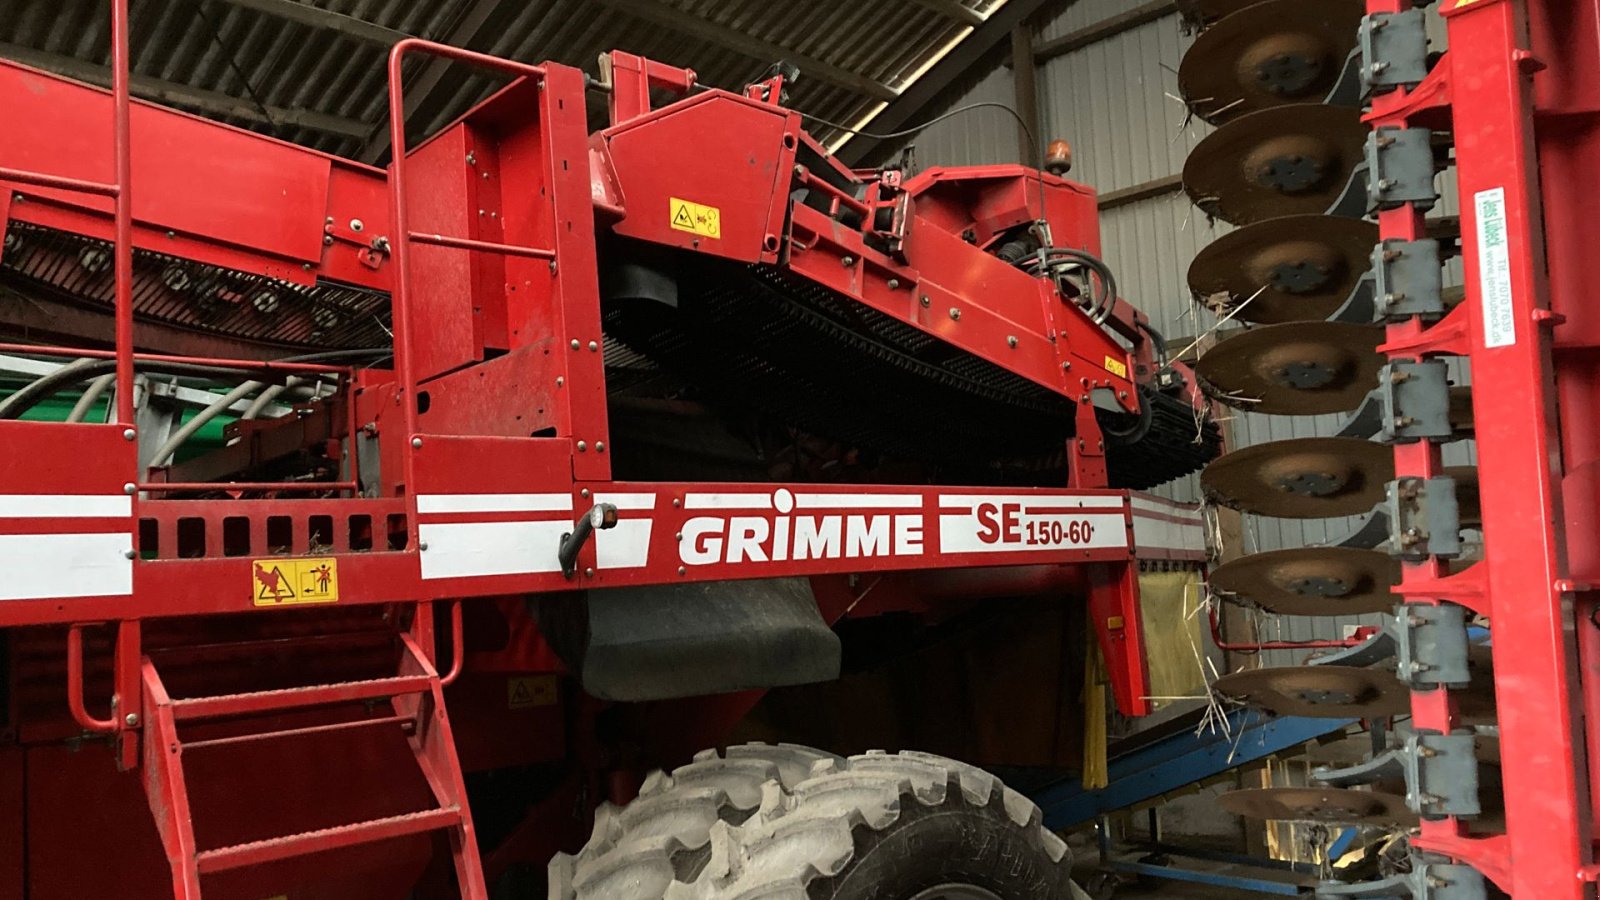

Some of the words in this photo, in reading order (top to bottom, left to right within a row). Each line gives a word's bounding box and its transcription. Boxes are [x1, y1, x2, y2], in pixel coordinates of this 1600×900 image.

[1483, 200, 1502, 218] Jens
[1484, 217, 1505, 248] Lübeck
[1486, 250, 1501, 343] www.jenslubeck.dk
[1499, 280, 1509, 305] 7070
[1501, 308, 1511, 332] 7639
[976, 502, 1021, 544] SE
[1026, 520, 1092, 545] 150-60
